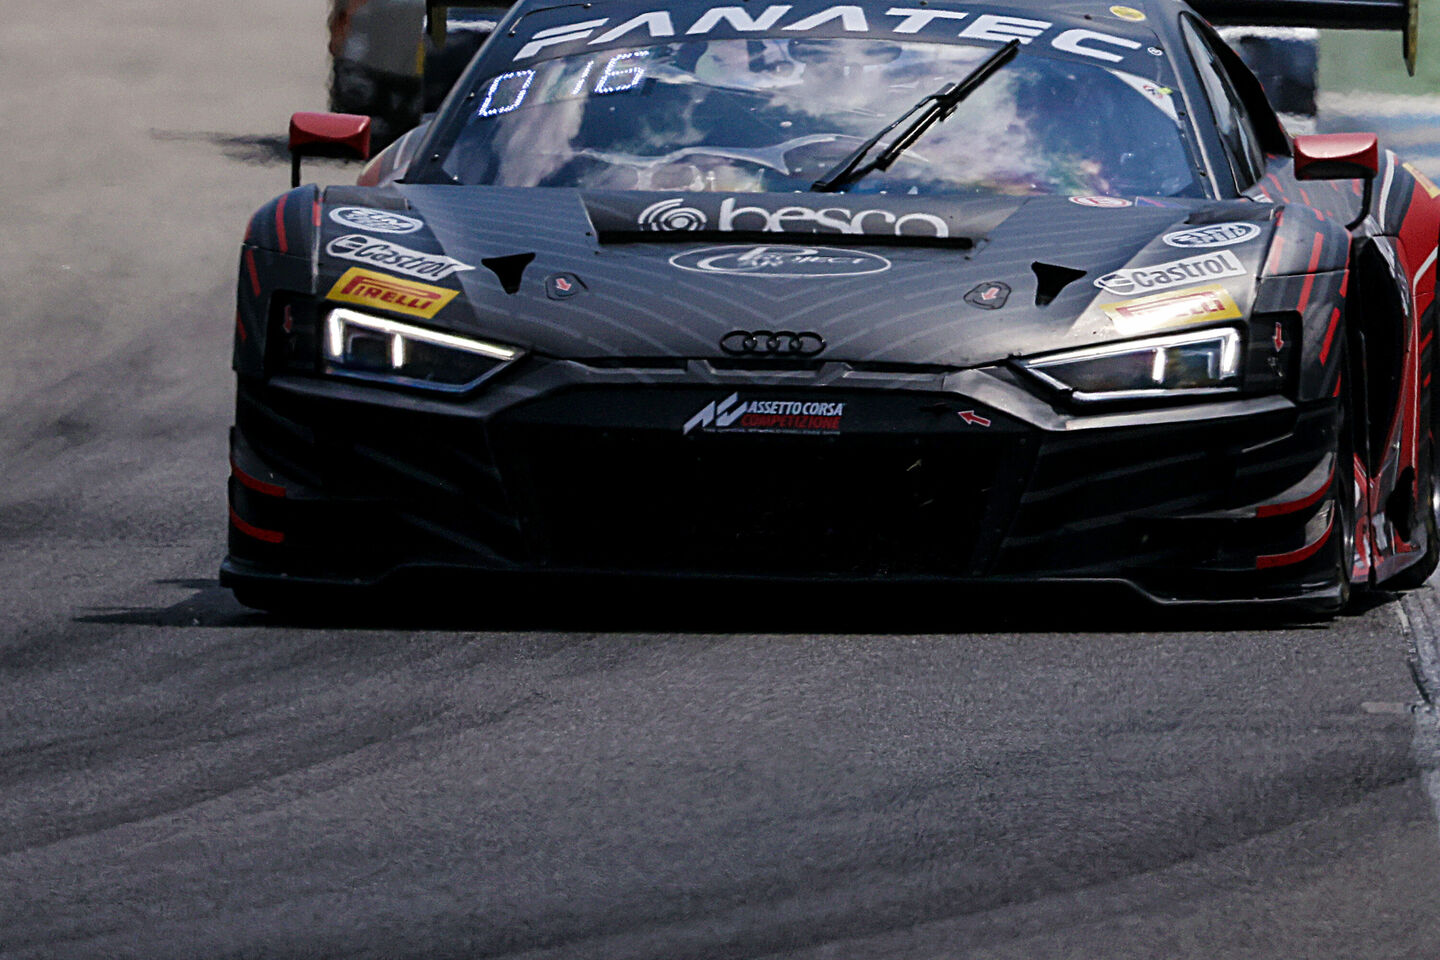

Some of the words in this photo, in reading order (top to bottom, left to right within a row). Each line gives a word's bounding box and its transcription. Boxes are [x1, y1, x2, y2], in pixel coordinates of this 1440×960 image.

[513, 5, 1142, 62] FANATEC
[354, 244, 460, 277] Castrol
[1131, 255, 1237, 288] Castrol
[341, 276, 442, 310] PIRELLI
[741, 414, 841, 429] COMPETIZIONE
[747, 401, 801, 415] ASSETTO
[802, 402, 844, 416] CORSA
